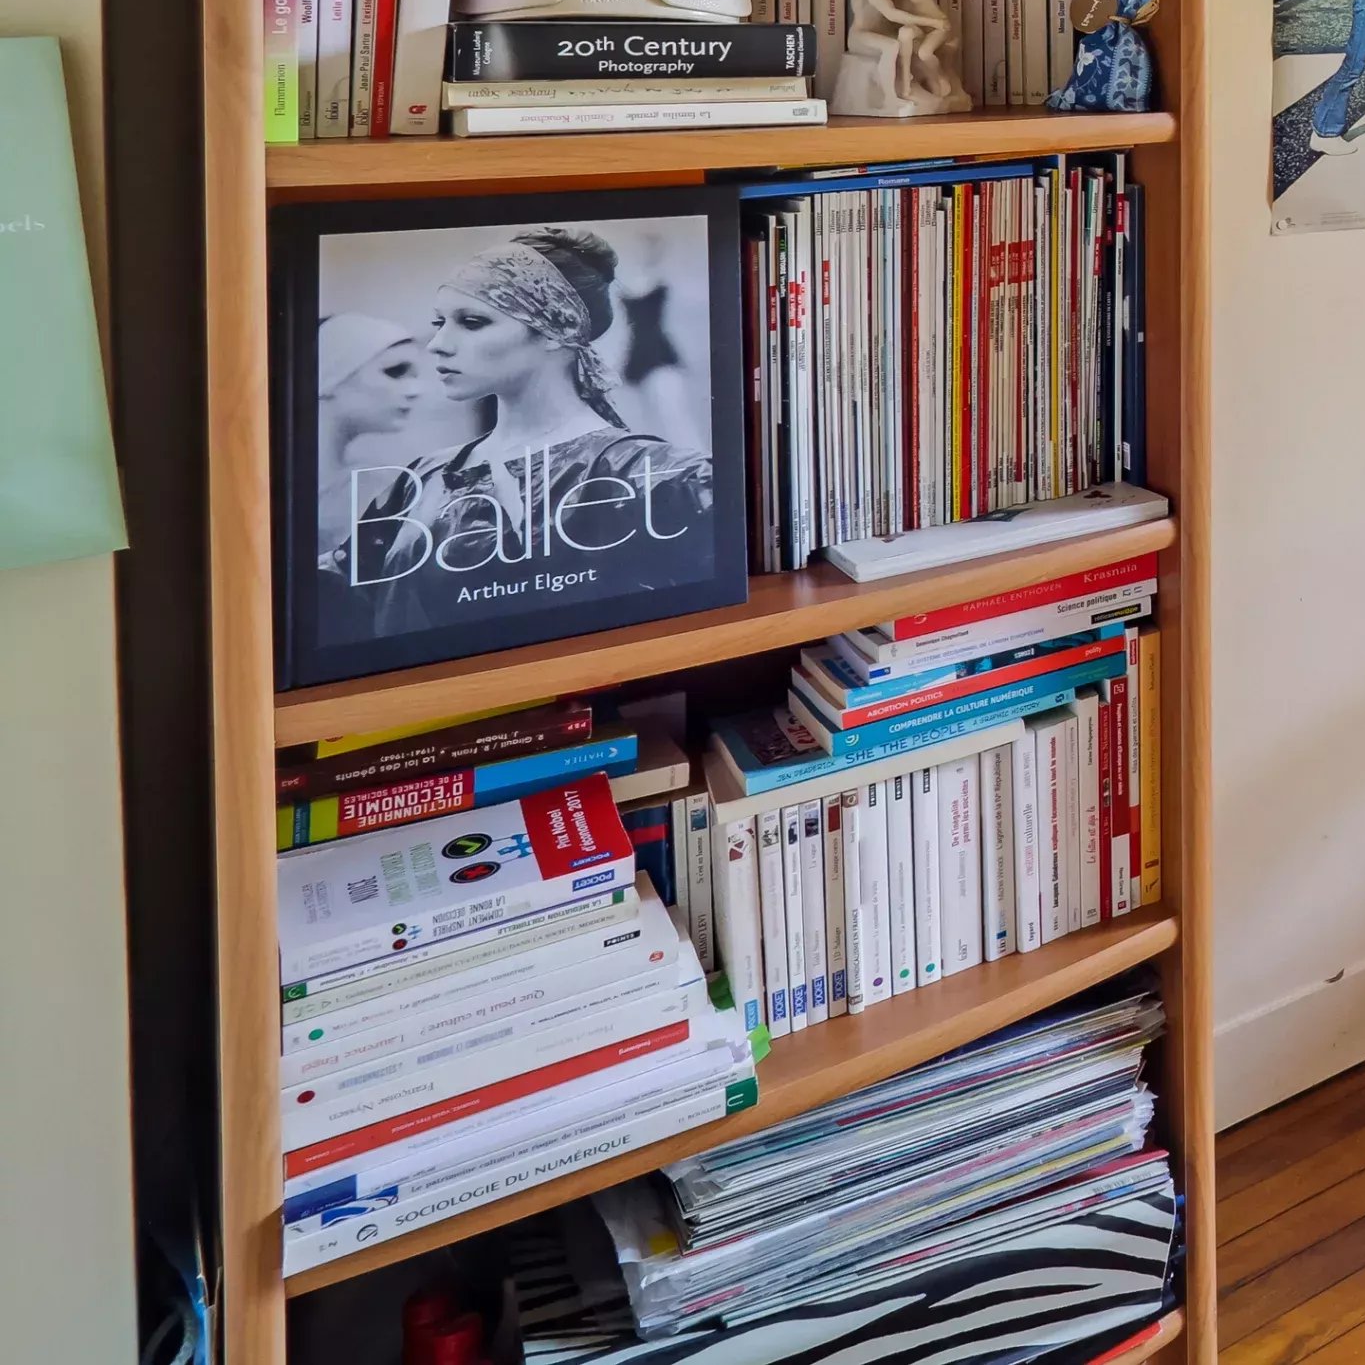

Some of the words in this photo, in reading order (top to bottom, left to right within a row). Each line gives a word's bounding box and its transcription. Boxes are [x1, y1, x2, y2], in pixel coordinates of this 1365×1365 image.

[272, 17, 288, 34] Le
[557, 37, 615, 57] 20th
[624, 35, 732, 62] Century
[786, 34, 795, 69] TASCHEN
[599, 59, 694, 74] Photography
[350, 443, 688, 588] Ballet
[1083, 562, 1138, 584] Krasnaïa
[457, 578, 529, 603] Arthur
[535, 567, 597, 596] Elgort
[962, 594, 1008, 613] RAPHAËL
[1009, 583, 1063, 604] ENTHOVEN
[1056, 600, 1085, 615] Science
[1086, 592, 1118, 609] politique
[867, 700, 909, 718] ABORTION
[910, 690, 943, 707] POLITICS
[889, 710, 943, 733] COMPRENDRE
[944, 707, 955, 719] LA
[956, 697, 989, 716] CULTURE
[990, 685, 1034, 706] NUMÉRIQUE
[980, 709, 1011, 725] GRAPHIC
[1012, 701, 1041, 718] HISTORY
[845, 748, 876, 764] SHE
[879, 739, 908, 755] THE
[911, 722, 966, 747] PEOPLE
[380, 762, 402, 773] des
[404, 758, 419, 769] loi
[421, 756, 437, 766] La
[564, 750, 605, 766] HATIER
[335, 763, 377, 782] géants
[440, 775, 450, 785] DE
[454, 772, 464, 781] ET
[344, 786, 390, 805] SOCIALES
[392, 778, 438, 797] SCIENCES
[565, 789, 582, 813] 2017
[357, 795, 463, 828] DICTIONNAIRE
[547, 808, 566, 835] Nobel
[555, 834, 572, 850] Prix
[574, 872, 613, 890] POCKET
[469, 898, 495, 914] BONNE
[468, 910, 504, 928] COMMENT
[395, 1181, 502, 1228] SOCIOLOGIE
[504, 1169, 530, 1187] DU
[534, 1133, 632, 1176] NUMÉRIQUE
